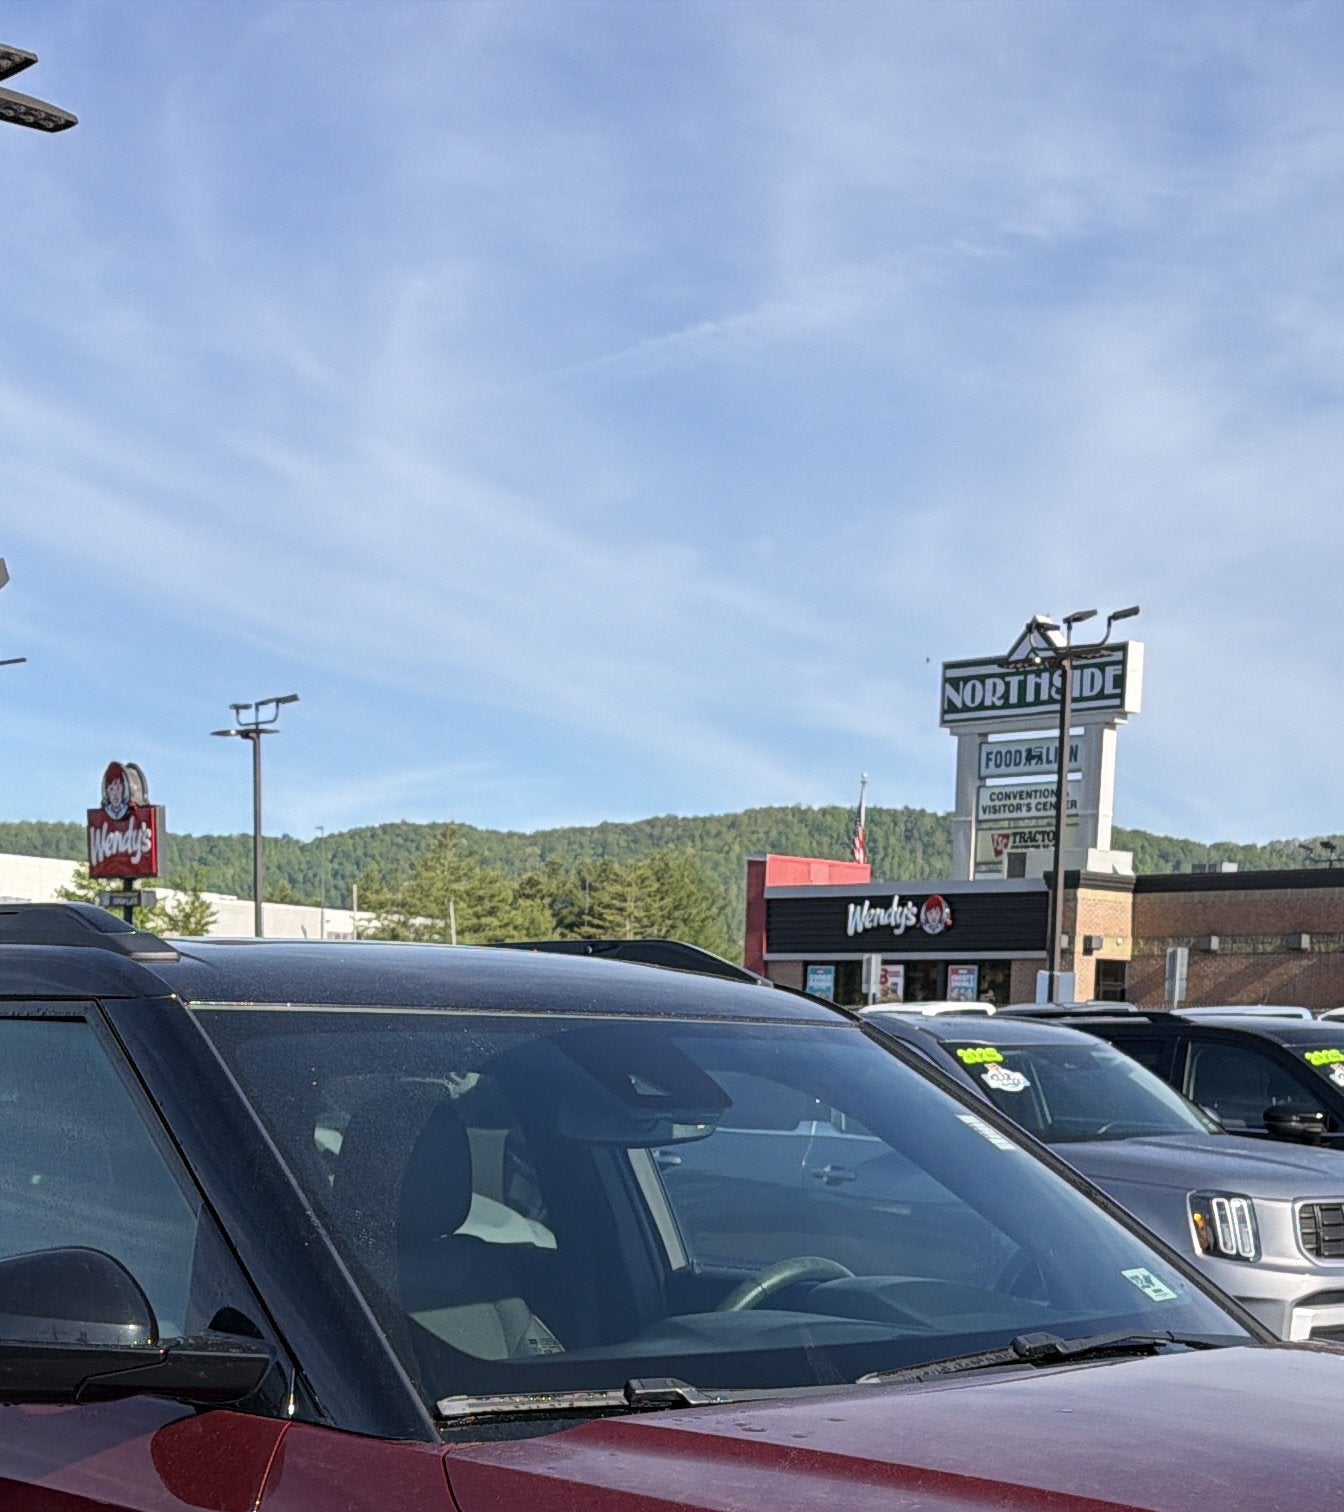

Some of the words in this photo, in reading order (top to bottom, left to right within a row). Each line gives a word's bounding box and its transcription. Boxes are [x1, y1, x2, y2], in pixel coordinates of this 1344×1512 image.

[984, 749, 1023, 770] FOOD
[1045, 745, 1079, 764] LIN
[989, 788, 1058, 803] CONVENTION
[981, 801, 1032, 815] VISITOR'S
[89, 815, 152, 866] Wendy's
[1011, 830, 1056, 844] TRACTO
[846, 894, 918, 937] Wendy's
